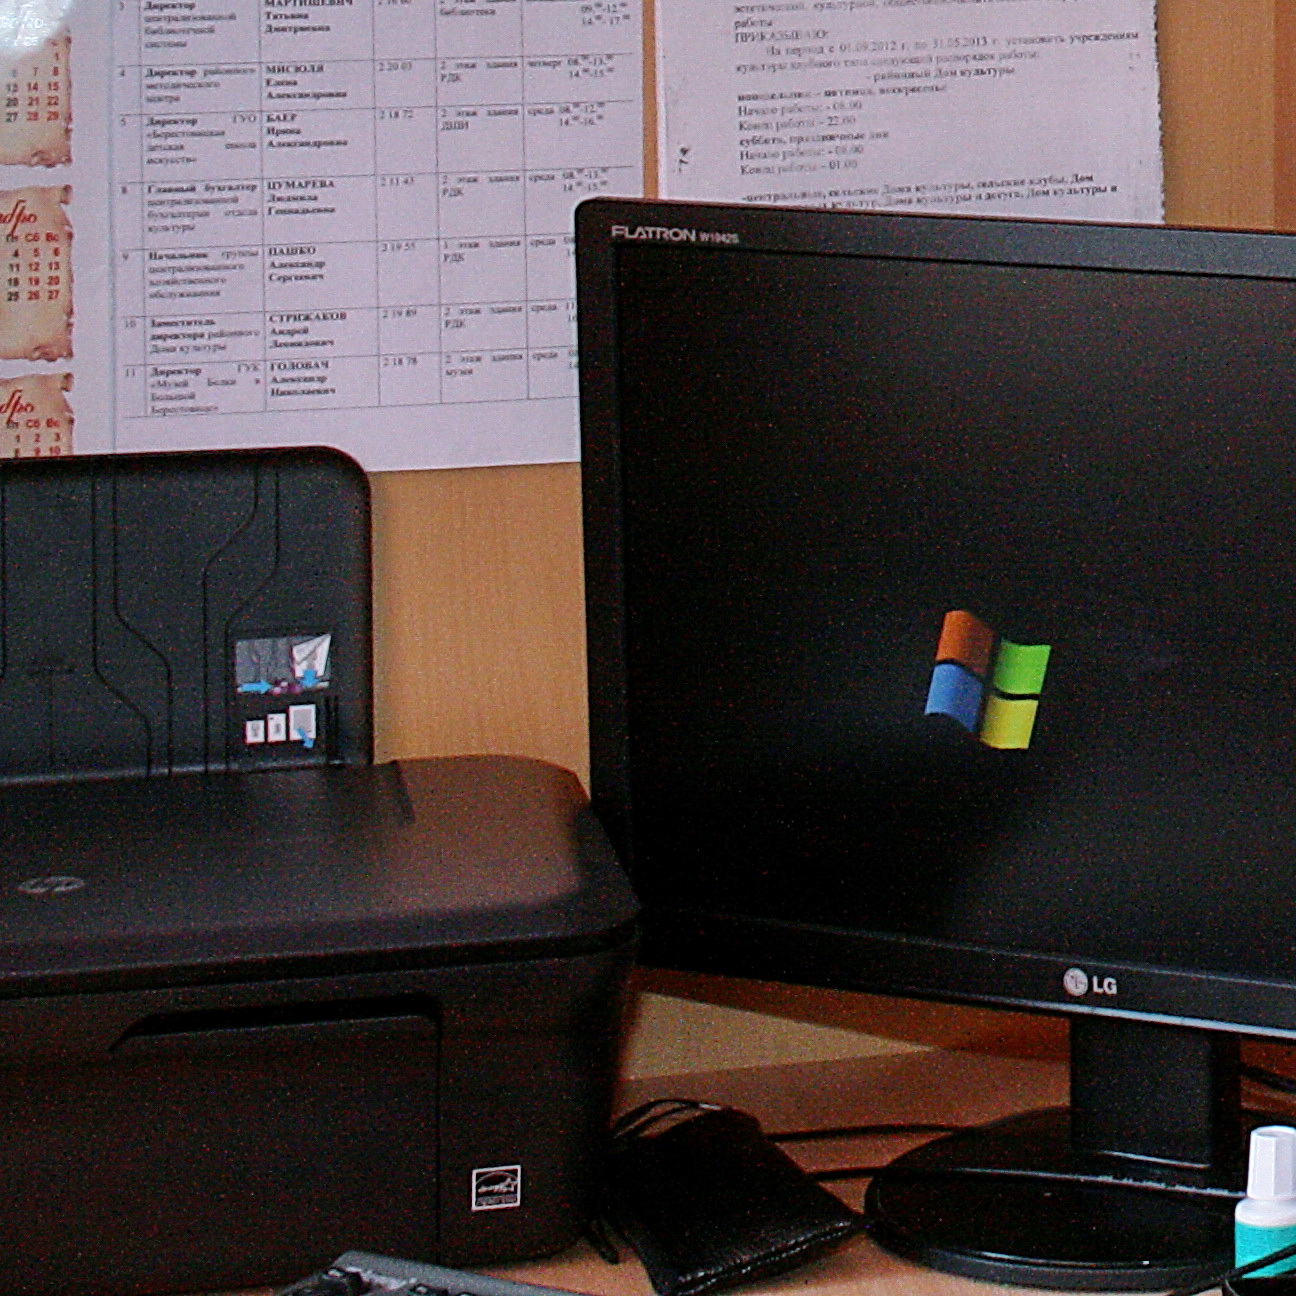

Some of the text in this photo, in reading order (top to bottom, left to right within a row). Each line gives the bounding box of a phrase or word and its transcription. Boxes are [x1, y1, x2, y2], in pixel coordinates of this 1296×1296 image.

[611, 225, 697, 243] FLATRON
[28, 262, 40, 272] 12
[48, 262, 60, 271] 13
[47, 290, 60, 300] 27
[1092, 975, 1117, 996] LG
